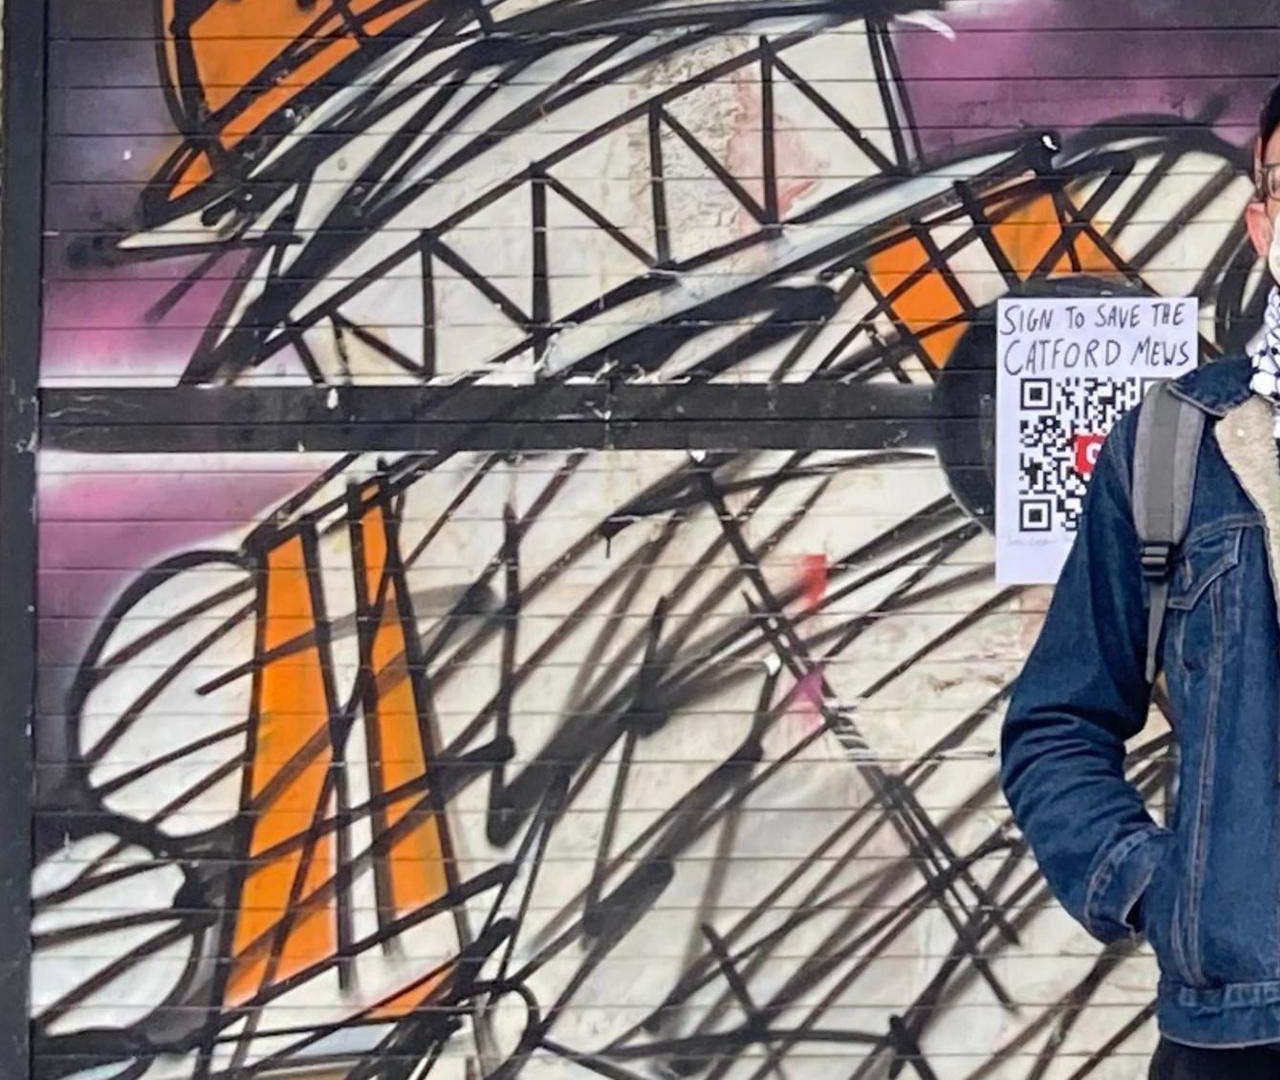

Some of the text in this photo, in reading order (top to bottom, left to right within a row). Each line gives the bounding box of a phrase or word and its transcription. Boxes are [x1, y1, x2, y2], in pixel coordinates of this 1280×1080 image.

[1000, 304, 1054, 335] SIGN
[1094, 304, 1141, 329] SAVE
[1152, 302, 1186, 327] THE
[1004, 336, 1190, 376] CATFORD MEWS
